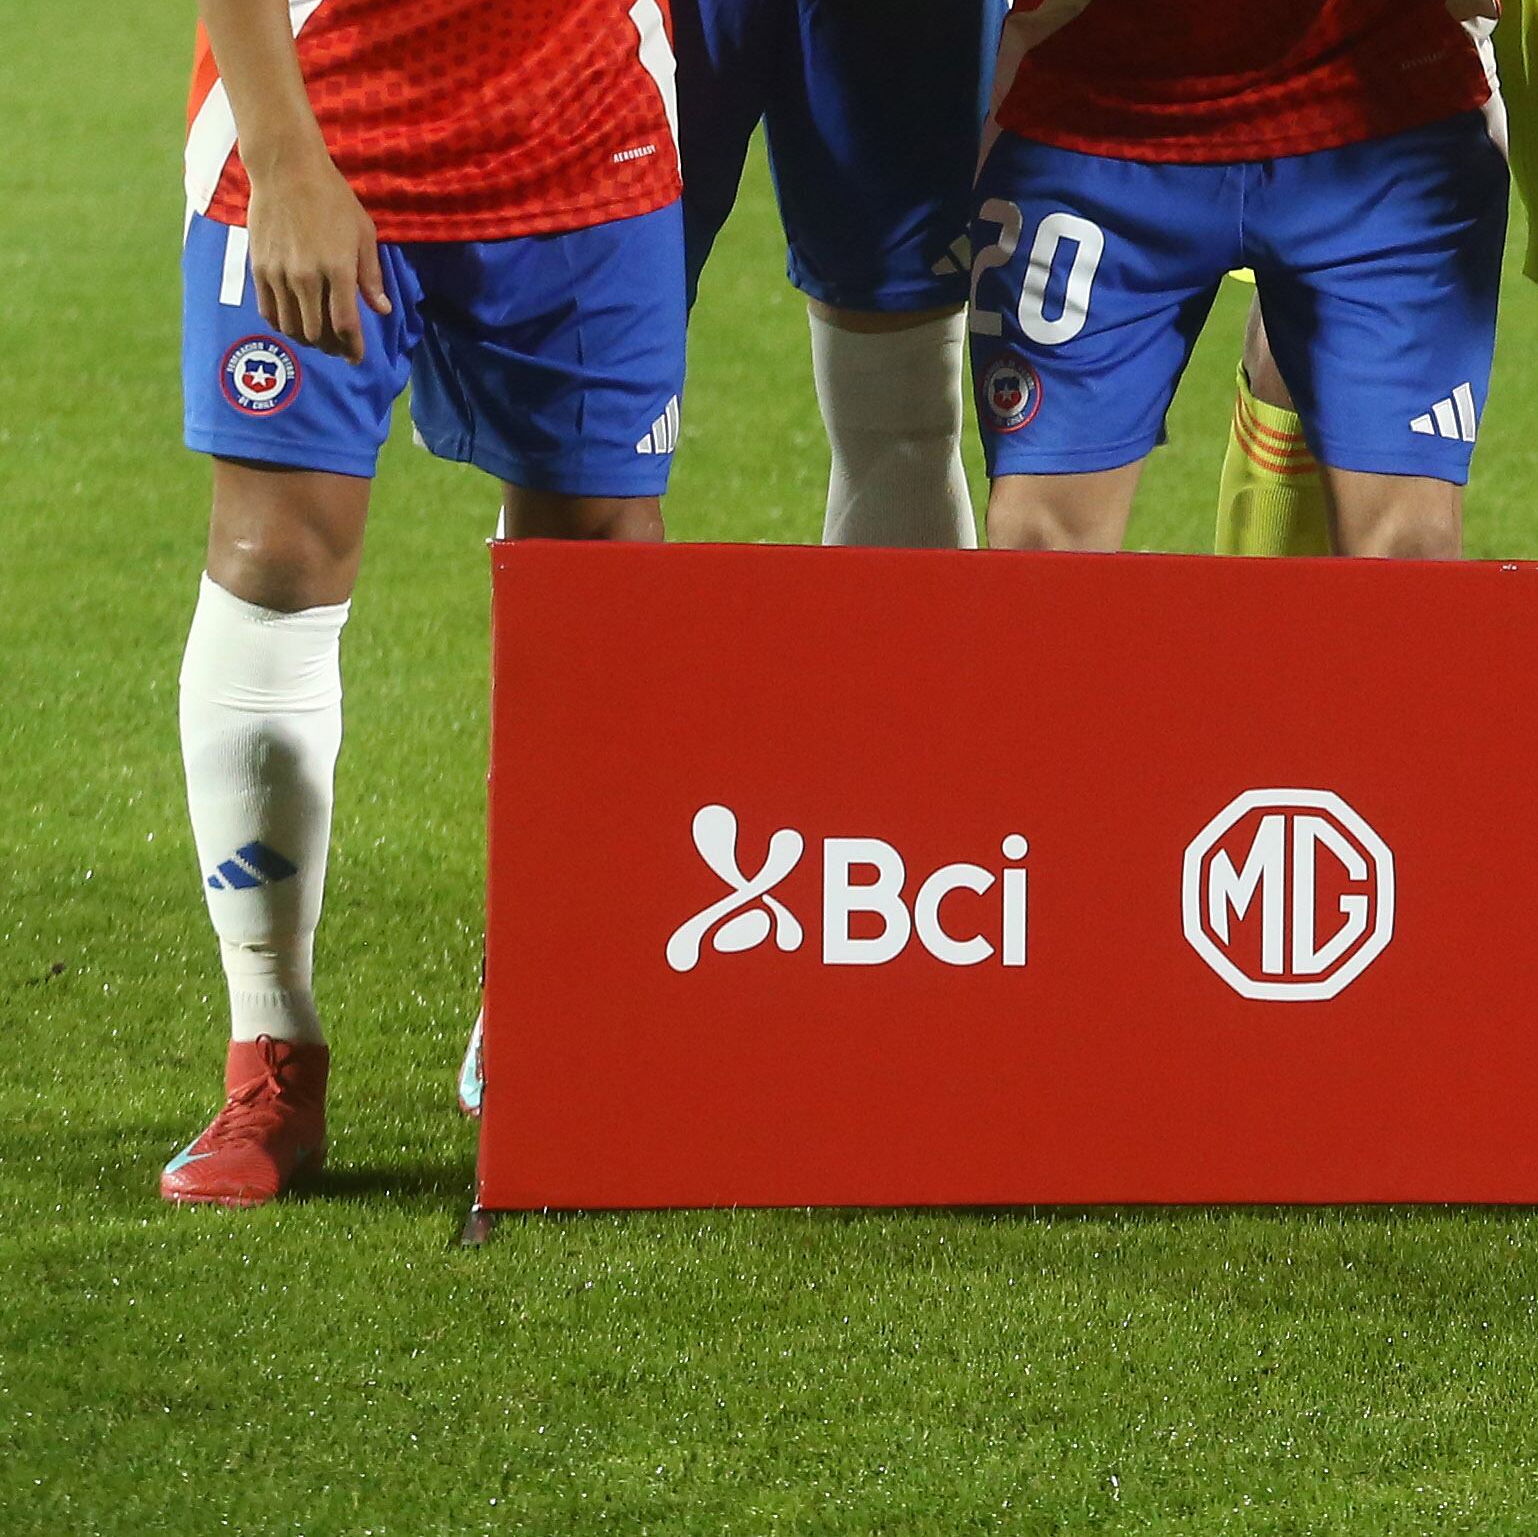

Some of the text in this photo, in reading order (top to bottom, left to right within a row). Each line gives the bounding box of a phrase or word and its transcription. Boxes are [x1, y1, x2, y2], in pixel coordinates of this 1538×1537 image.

[970, 198, 1104, 345] 20
[823, 834, 1028, 966] Bci
[1209, 814, 1368, 975] MG
